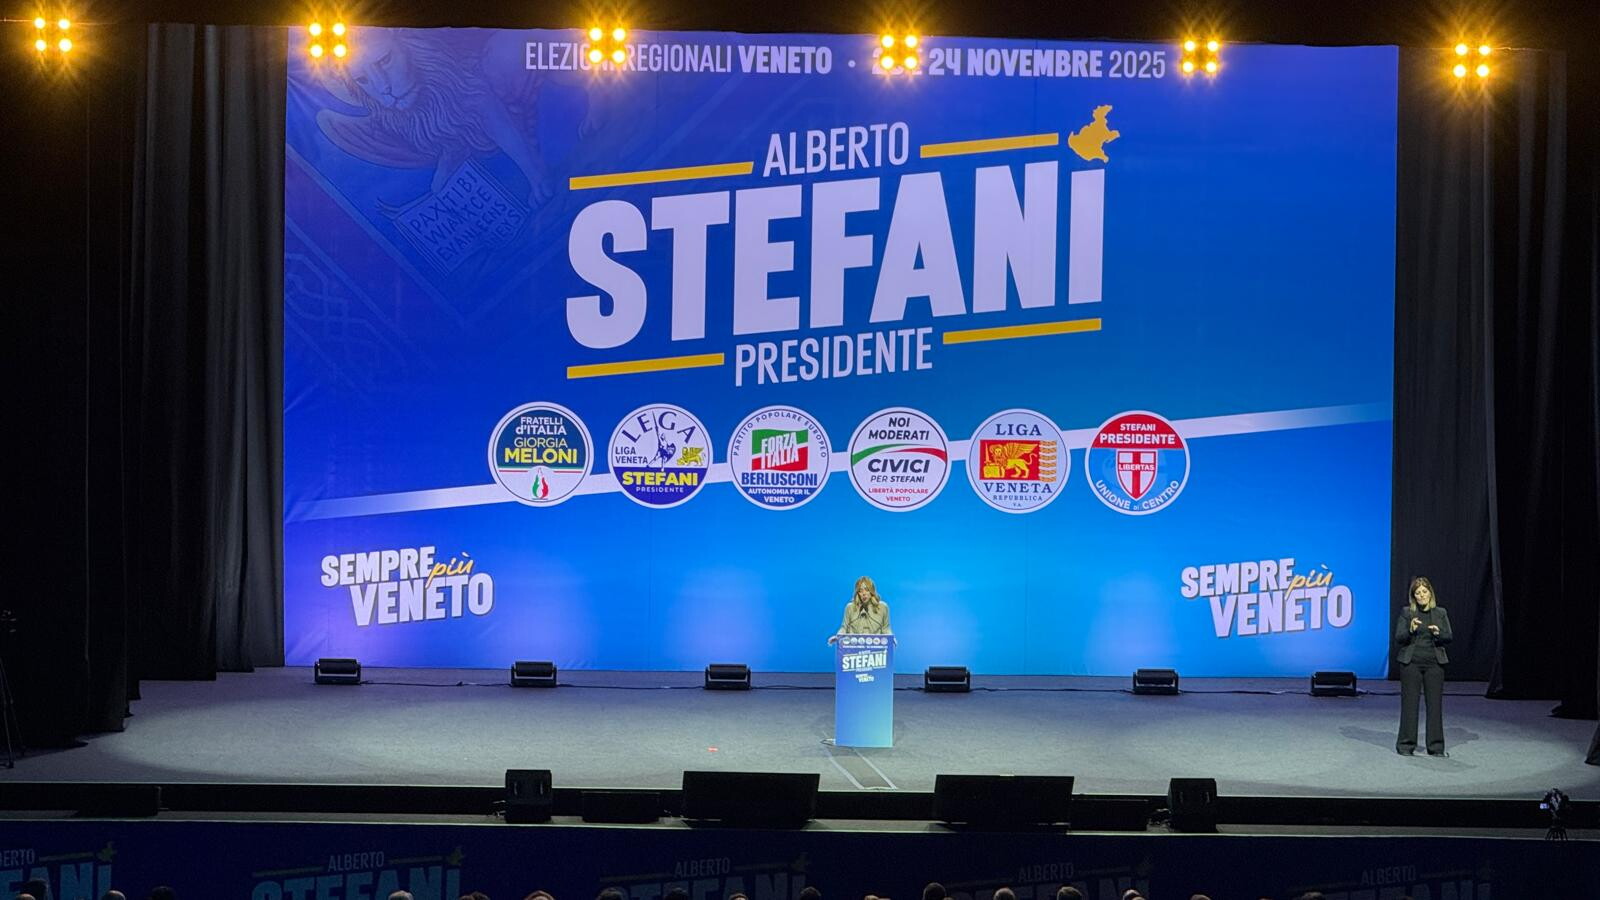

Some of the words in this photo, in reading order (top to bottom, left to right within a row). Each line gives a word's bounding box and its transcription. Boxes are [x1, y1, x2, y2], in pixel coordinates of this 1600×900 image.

[625, 44, 733, 74] REGIONALI
[738, 45, 832, 75] VENETO
[929, 48, 961, 76] 24
[966, 49, 1103, 78] NOVEMBRE
[1109, 51, 1166, 79] 2025
[763, 121, 909, 178] ALBERTO
[566, 160, 1105, 349] STEFANI
[735, 326, 933, 387] PRESIDENTE
[515, 425, 567, 435] d'ITALIA
[520, 416, 563, 425] FRATELLI
[621, 411, 696, 443] LEGA
[888, 417, 910, 427] NOI
[995, 423, 1042, 436] LIGA
[1120, 423, 1156, 431] STEFANI
[514, 437, 568, 448] GIORGIA
[733, 421, 754, 457] PARTITO
[755, 411, 802, 423] POPOLARE
[804, 420, 827, 458] EUROPEO
[761, 432, 797, 452] FORZA
[868, 430, 930, 441] MODERATI
[1100, 433, 1176, 445] PRESIDENTE
[505, 448, 577, 463] MELONI
[615, 446, 636, 455] LIGA
[615, 455, 648, 464] VENETA
[760, 447, 799, 469] ITALIA
[867, 458, 930, 474] CIVICI
[622, 471, 698, 486] STEFANI
[742, 472, 817, 486] BERLUSCONI
[870, 475, 888, 483] PER
[889, 475, 925, 483] STEFANI
[983, 482, 1053, 494] VENETA
[1096, 480, 1130, 510] UNIONE
[1142, 480, 1180, 509] CENTRO
[321, 546, 436, 587] SEMPRE
[425, 551, 474, 589] più
[1181, 558, 1295, 599] SEMPRE
[1285, 563, 1333, 601] più
[349, 572, 494, 627] VENETO
[1209, 585, 1352, 638] VENETO
[842, 653, 887, 670] STEFANI
[328, 851, 385, 872] ALBERTO
[674, 857, 732, 879] ALBERTO
[1020, 863, 1074, 882] ALBERTO
[1361, 865, 1417, 887] ALBERTO
